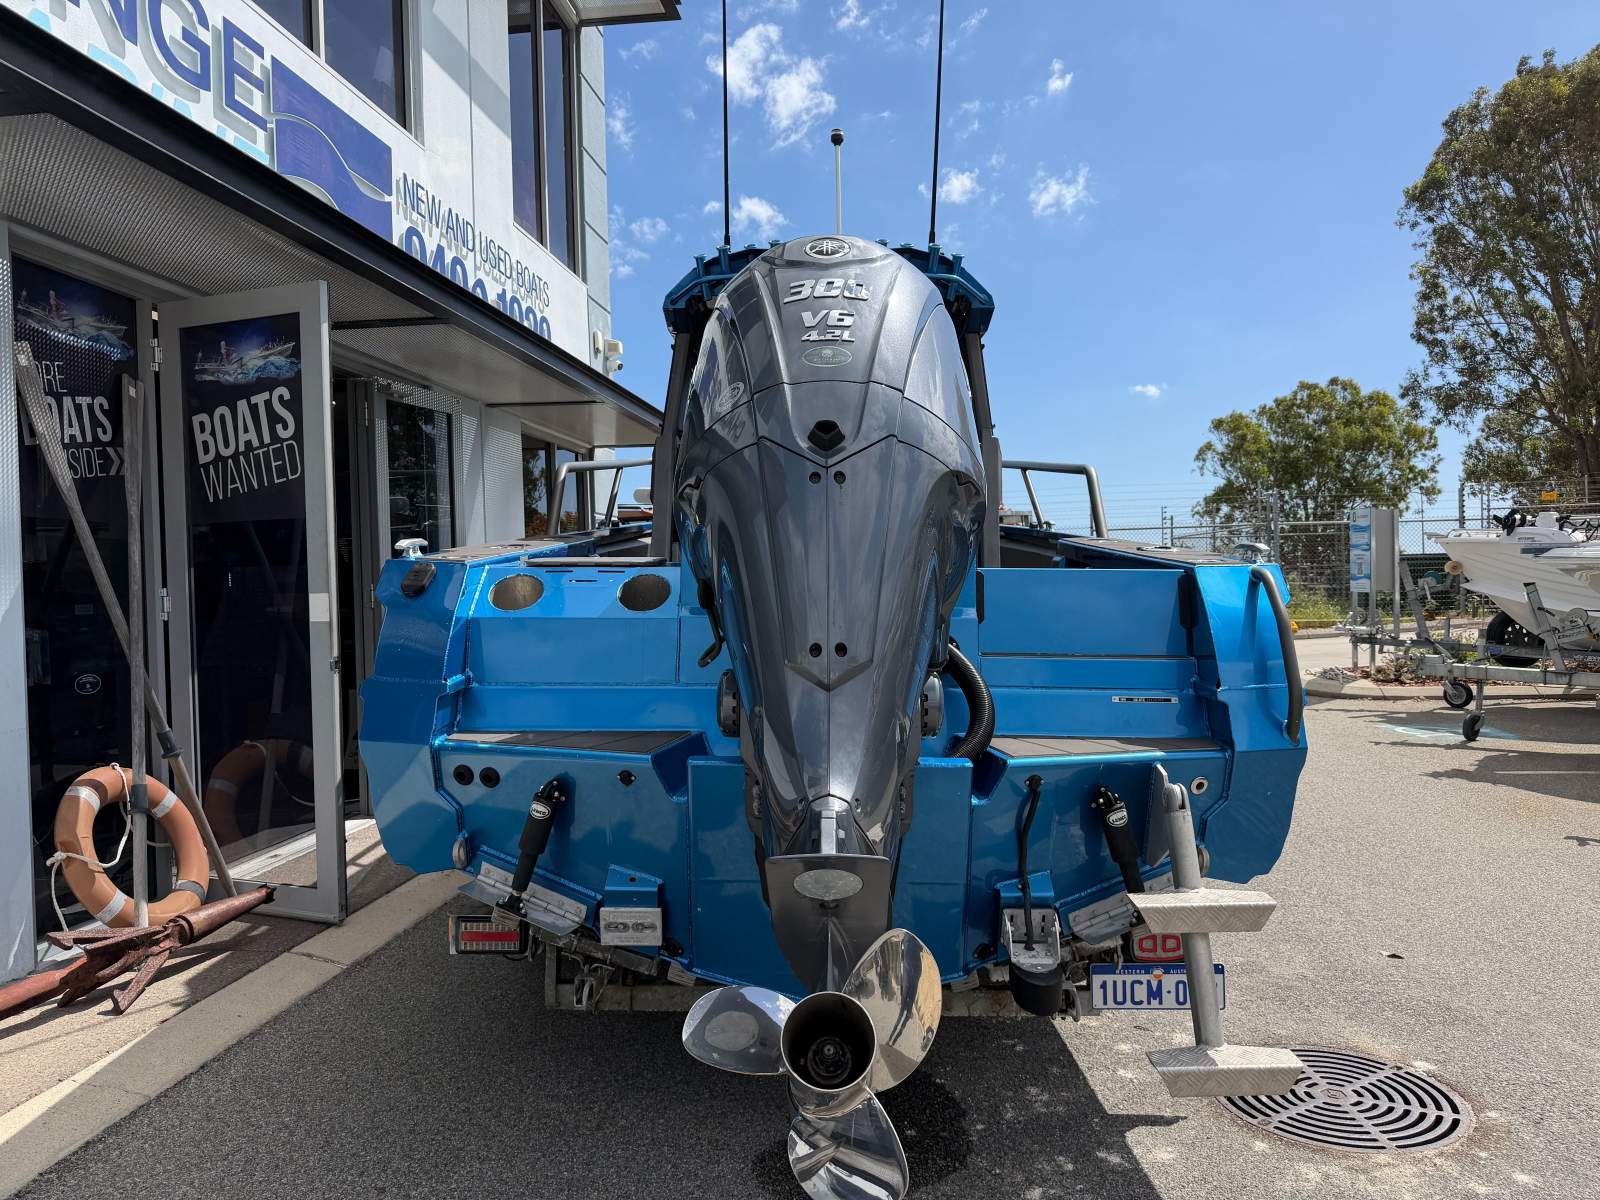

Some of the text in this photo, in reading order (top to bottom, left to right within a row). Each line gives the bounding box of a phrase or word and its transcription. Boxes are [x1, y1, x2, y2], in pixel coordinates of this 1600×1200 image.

[402, 172, 441, 229] NEW
[445, 207, 475, 252] AND
[479, 231, 512, 280] USED
[516, 259, 550, 308] BOATS
[783, 278, 873, 304] 300
[801, 309, 855, 328] V6
[801, 329, 855, 342] 4.2L
[191, 386, 296, 465] BOATS
[65, 448, 107, 479] SIDE
[200, 440, 301, 503] WANTED
